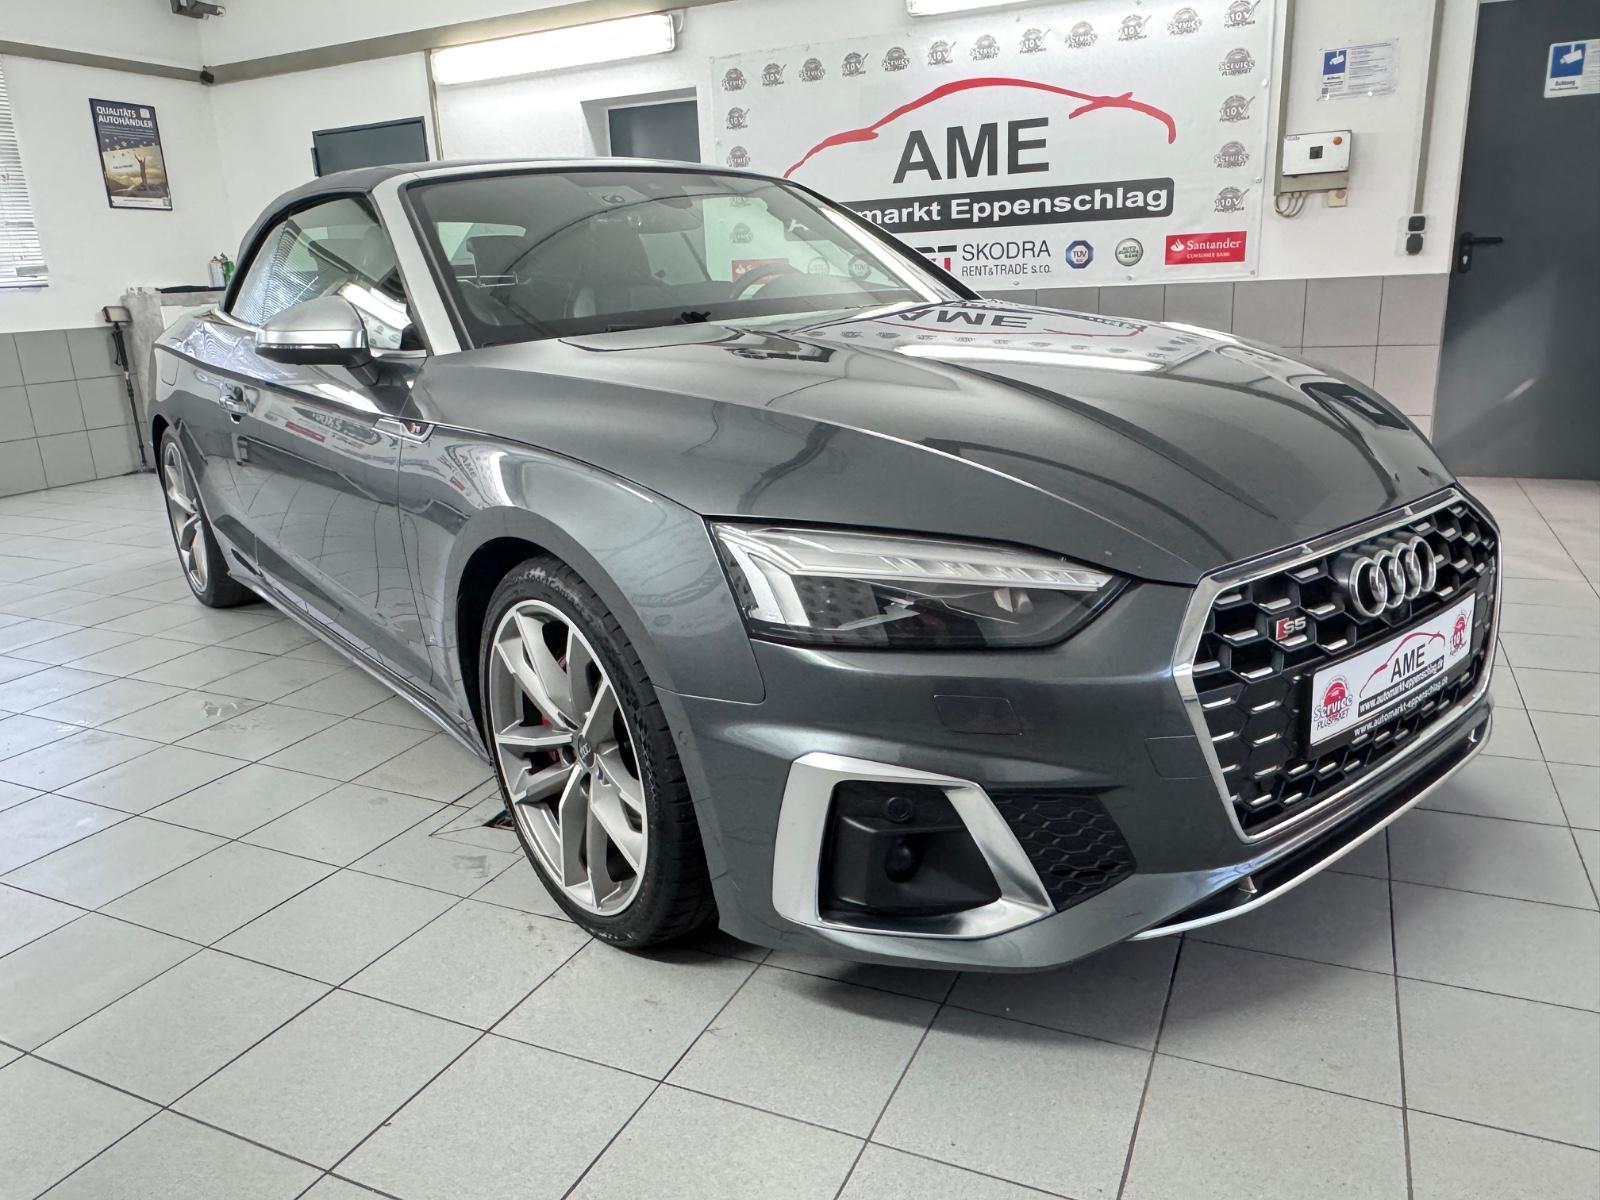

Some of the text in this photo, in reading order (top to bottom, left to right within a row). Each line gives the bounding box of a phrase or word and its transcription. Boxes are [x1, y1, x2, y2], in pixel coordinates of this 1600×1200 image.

[97, 106, 136, 118] QUALITÄTS
[98, 115, 153, 129] AUTOHÄNDLER
[892, 116, 1050, 184] AME
[950, 186, 1169, 223] Eppenschlag
[961, 239, 1052, 261] SKODRA
[1186, 237, 1242, 251] Santander
[1282, 616, 1307, 635] S5
[1390, 643, 1426, 683] AME
[1313, 694, 1354, 722] Service
